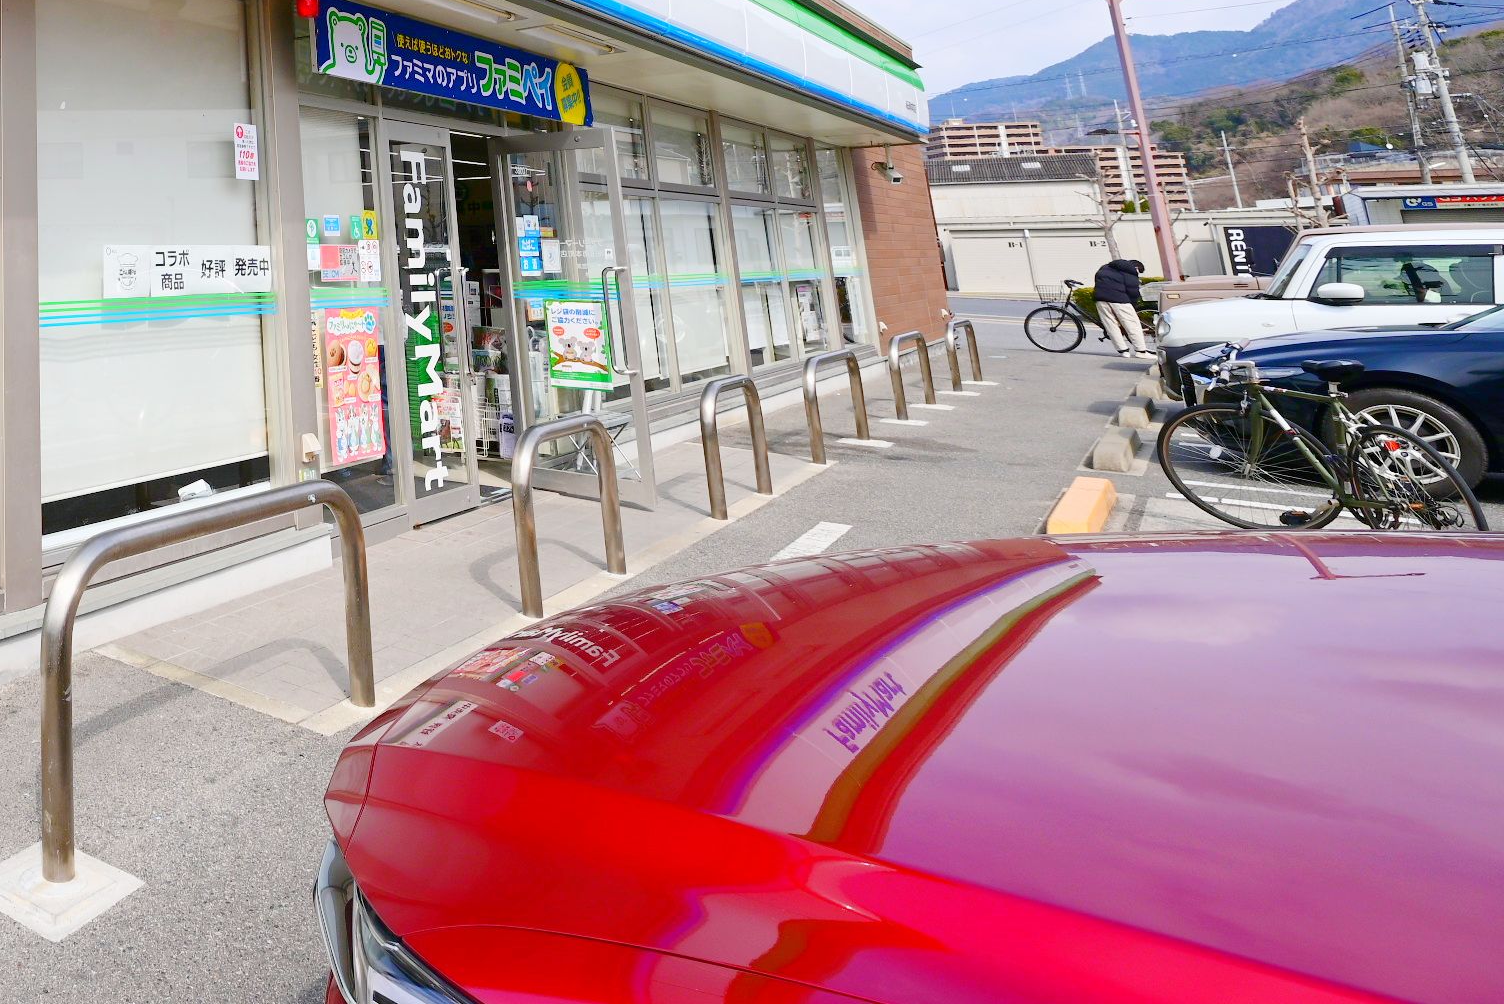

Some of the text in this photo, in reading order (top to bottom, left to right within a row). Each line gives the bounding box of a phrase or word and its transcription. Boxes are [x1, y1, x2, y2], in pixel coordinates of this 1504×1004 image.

[391, 54, 477, 94] ファミマのアプリ
[475, 51, 553, 111] ファミペイ
[155, 249, 190, 267] コラボ
[201, 257, 270, 279] 好評 発売中
[161, 272, 185, 291] 商品
[400, 150, 449, 492] FamilyMart
[551, 308, 596, 316] レジ袋の削減に
[551, 316, 599, 325] ご協力ください。
